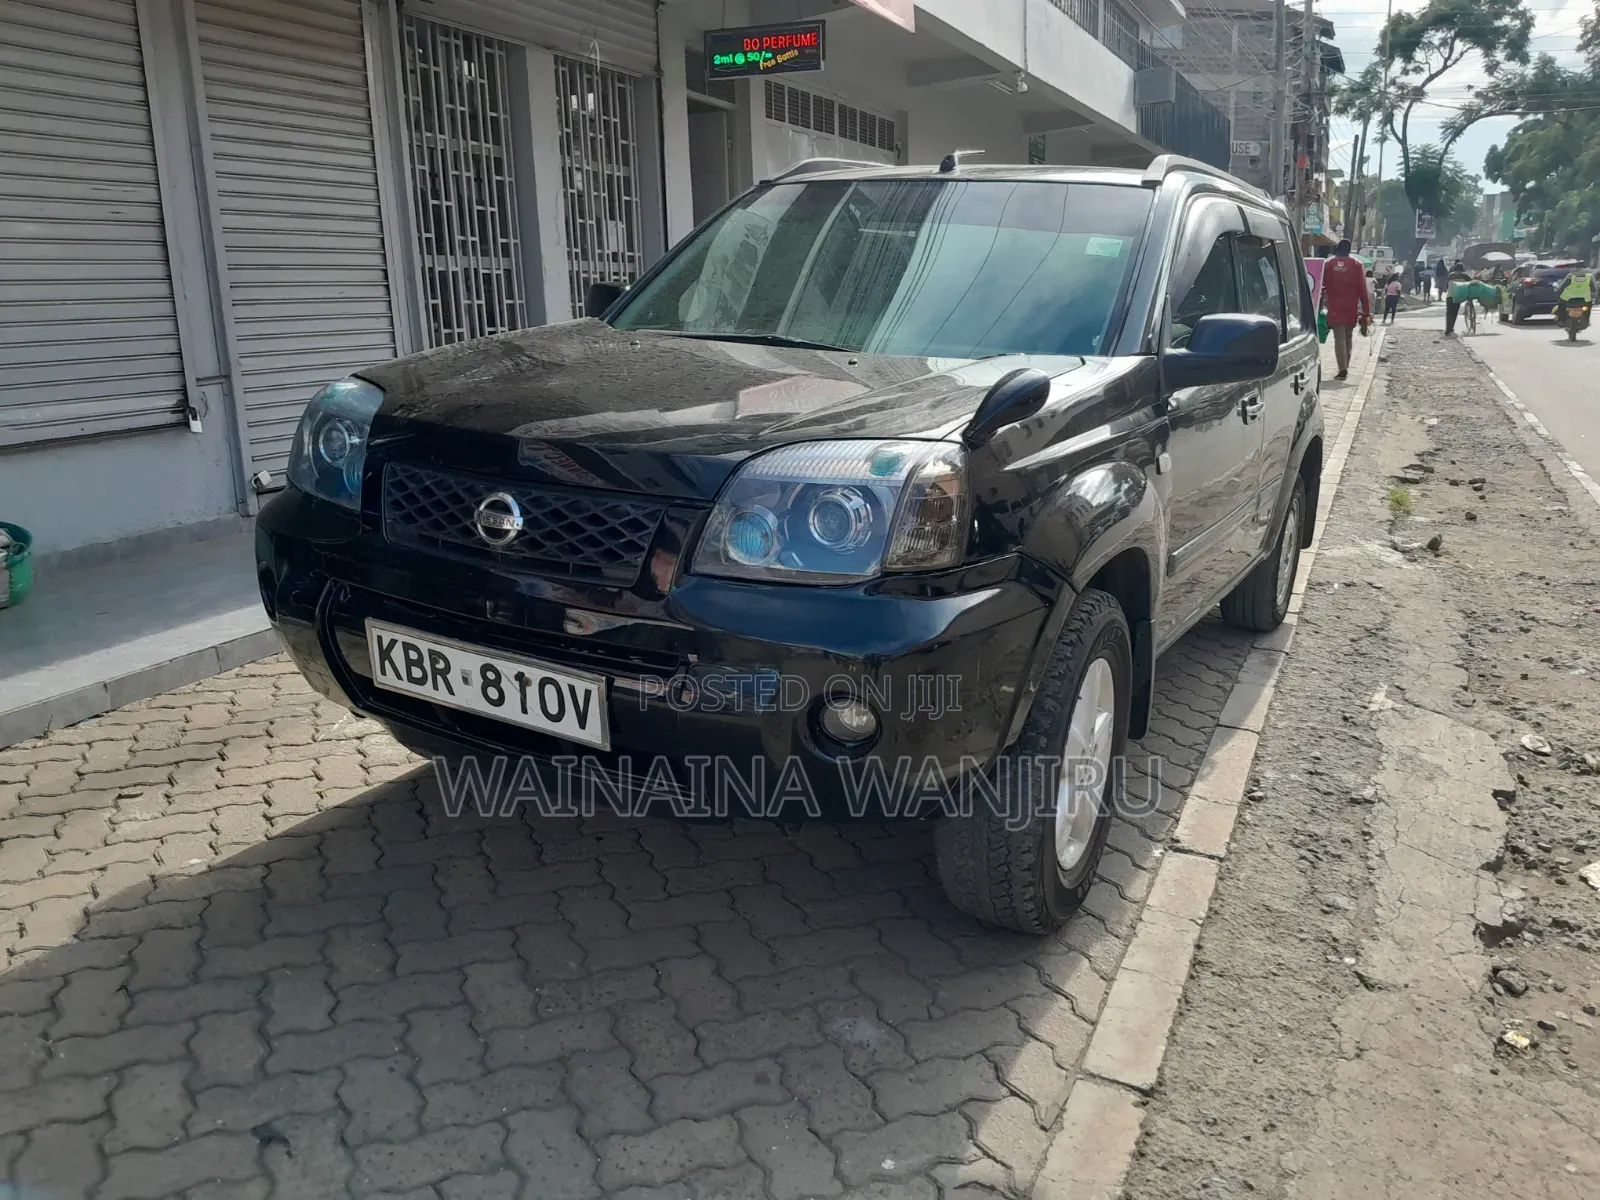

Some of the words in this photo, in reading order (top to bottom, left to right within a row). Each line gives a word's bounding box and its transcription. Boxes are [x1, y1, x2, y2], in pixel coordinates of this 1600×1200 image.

[763, 32, 818, 49] PERFUME
[376, 634, 456, 696] KBR
[479, 663, 592, 731] 810V
